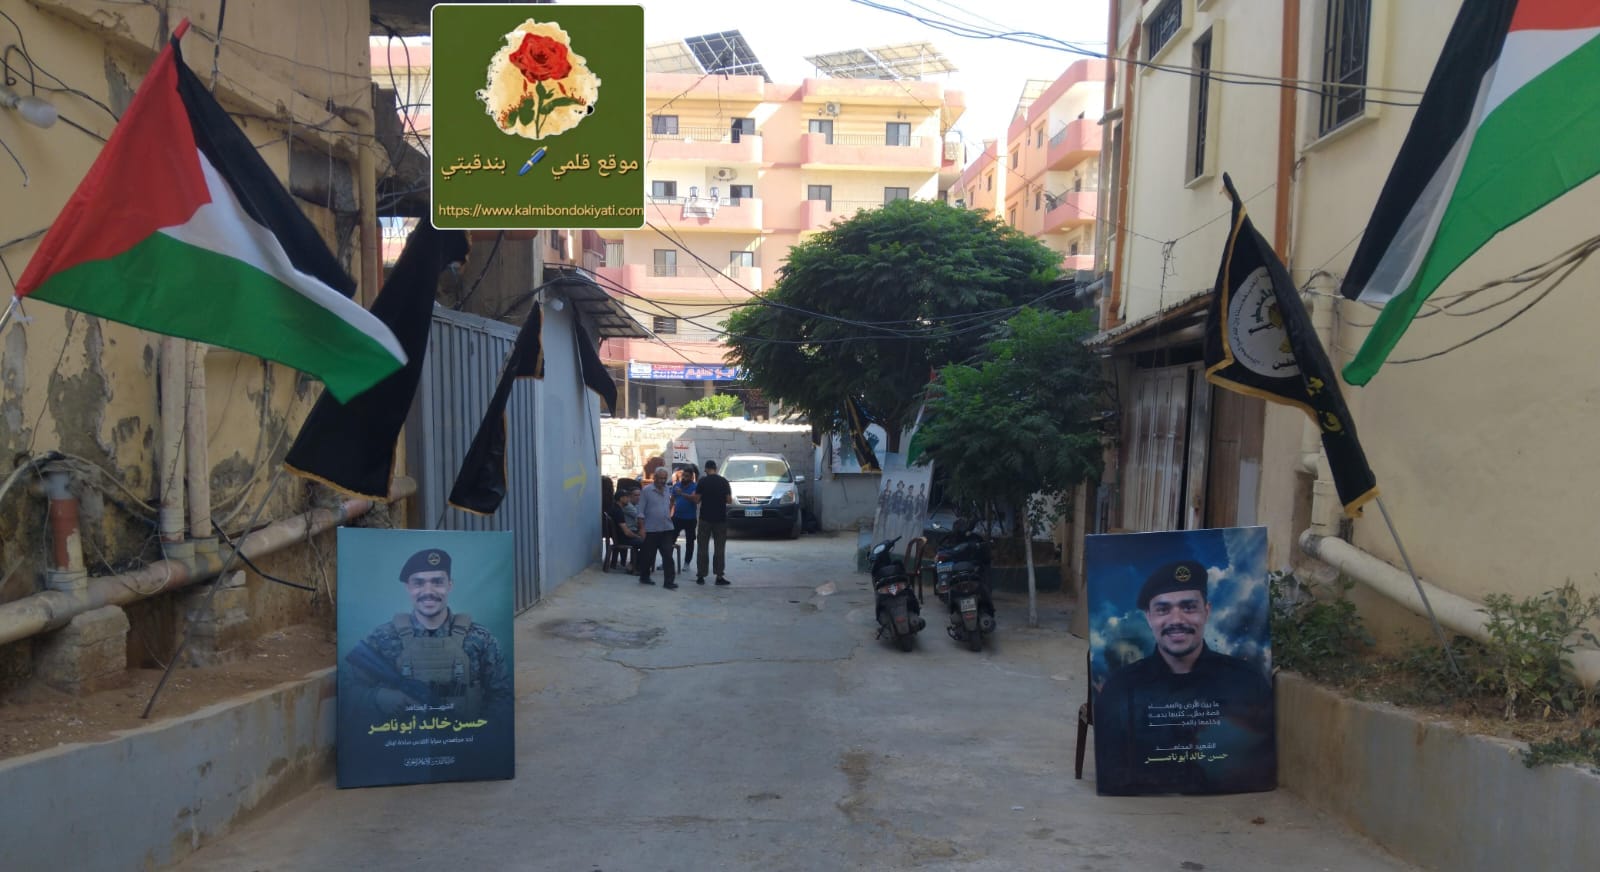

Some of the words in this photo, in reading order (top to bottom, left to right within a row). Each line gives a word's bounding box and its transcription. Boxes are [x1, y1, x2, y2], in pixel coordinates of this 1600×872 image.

[368, 717, 399, 735] ناصر
[399, 714, 417, 734] أبو
[419, 716, 452, 730] خالد
[452, 717, 489, 732] حسن
[1144, 752, 1178, 764] ناصر
[1177, 750, 1189, 763] أبو
[1189, 751, 1206, 761] خالد
[1207, 752, 1229, 762] حسن
